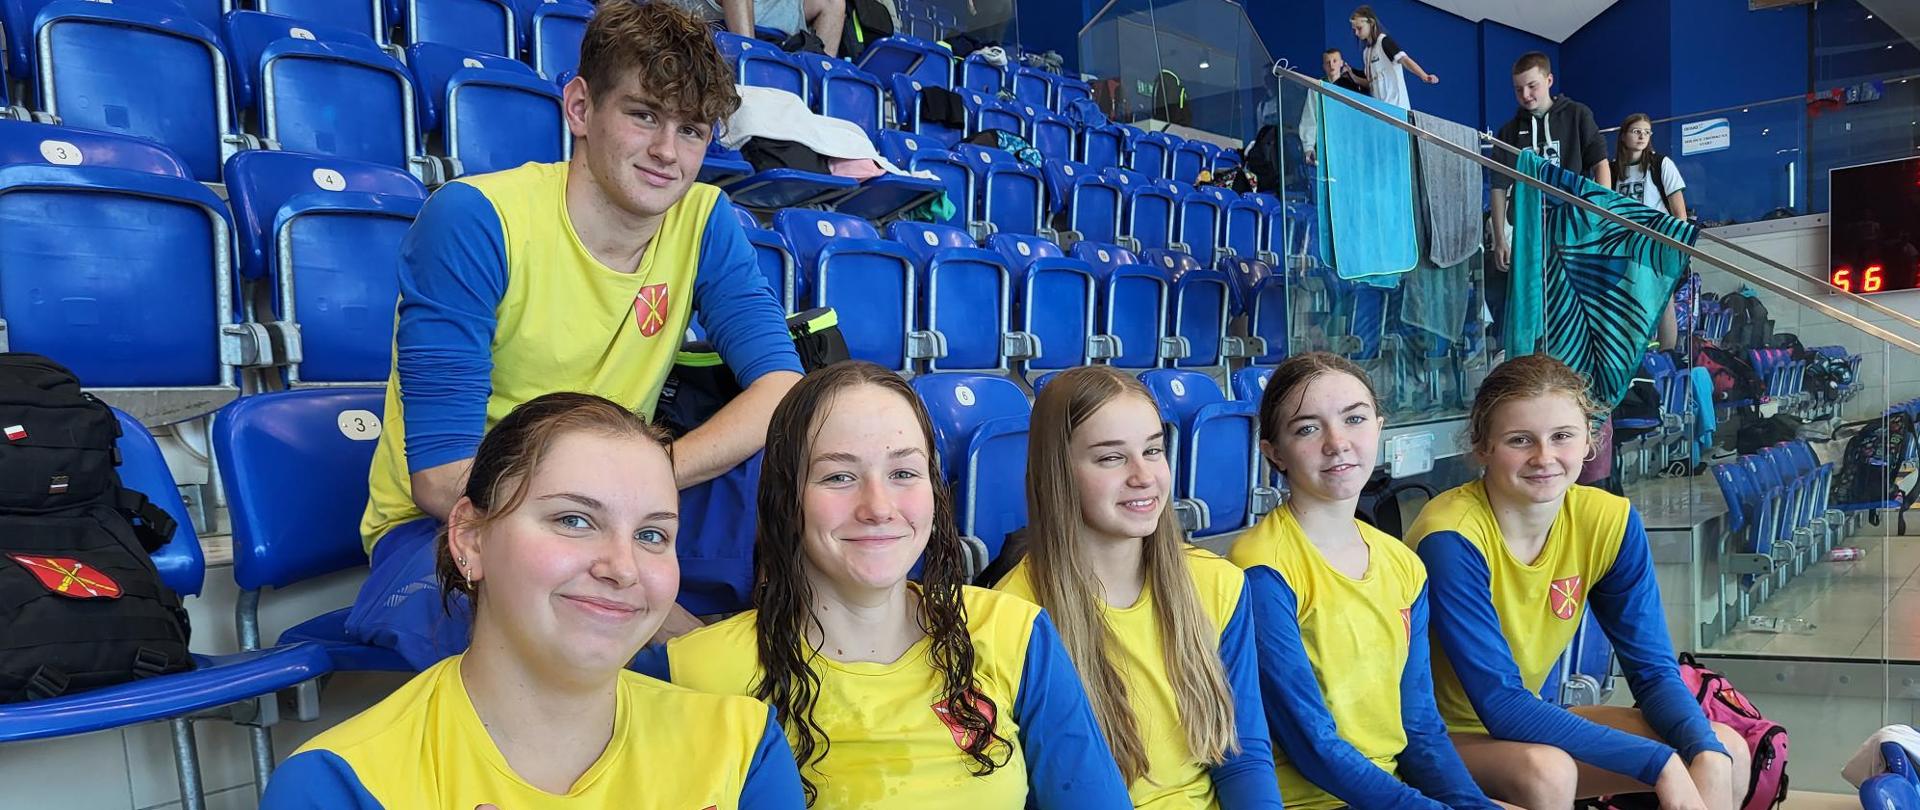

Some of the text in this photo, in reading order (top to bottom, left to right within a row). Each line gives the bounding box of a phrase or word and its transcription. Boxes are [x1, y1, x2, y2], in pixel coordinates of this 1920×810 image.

[56, 147, 67, 160] 3
[326, 175, 333, 184] 4
[1863, 265, 1881, 291] 6
[961, 391, 968, 400] 6
[354, 417, 366, 432] 3
